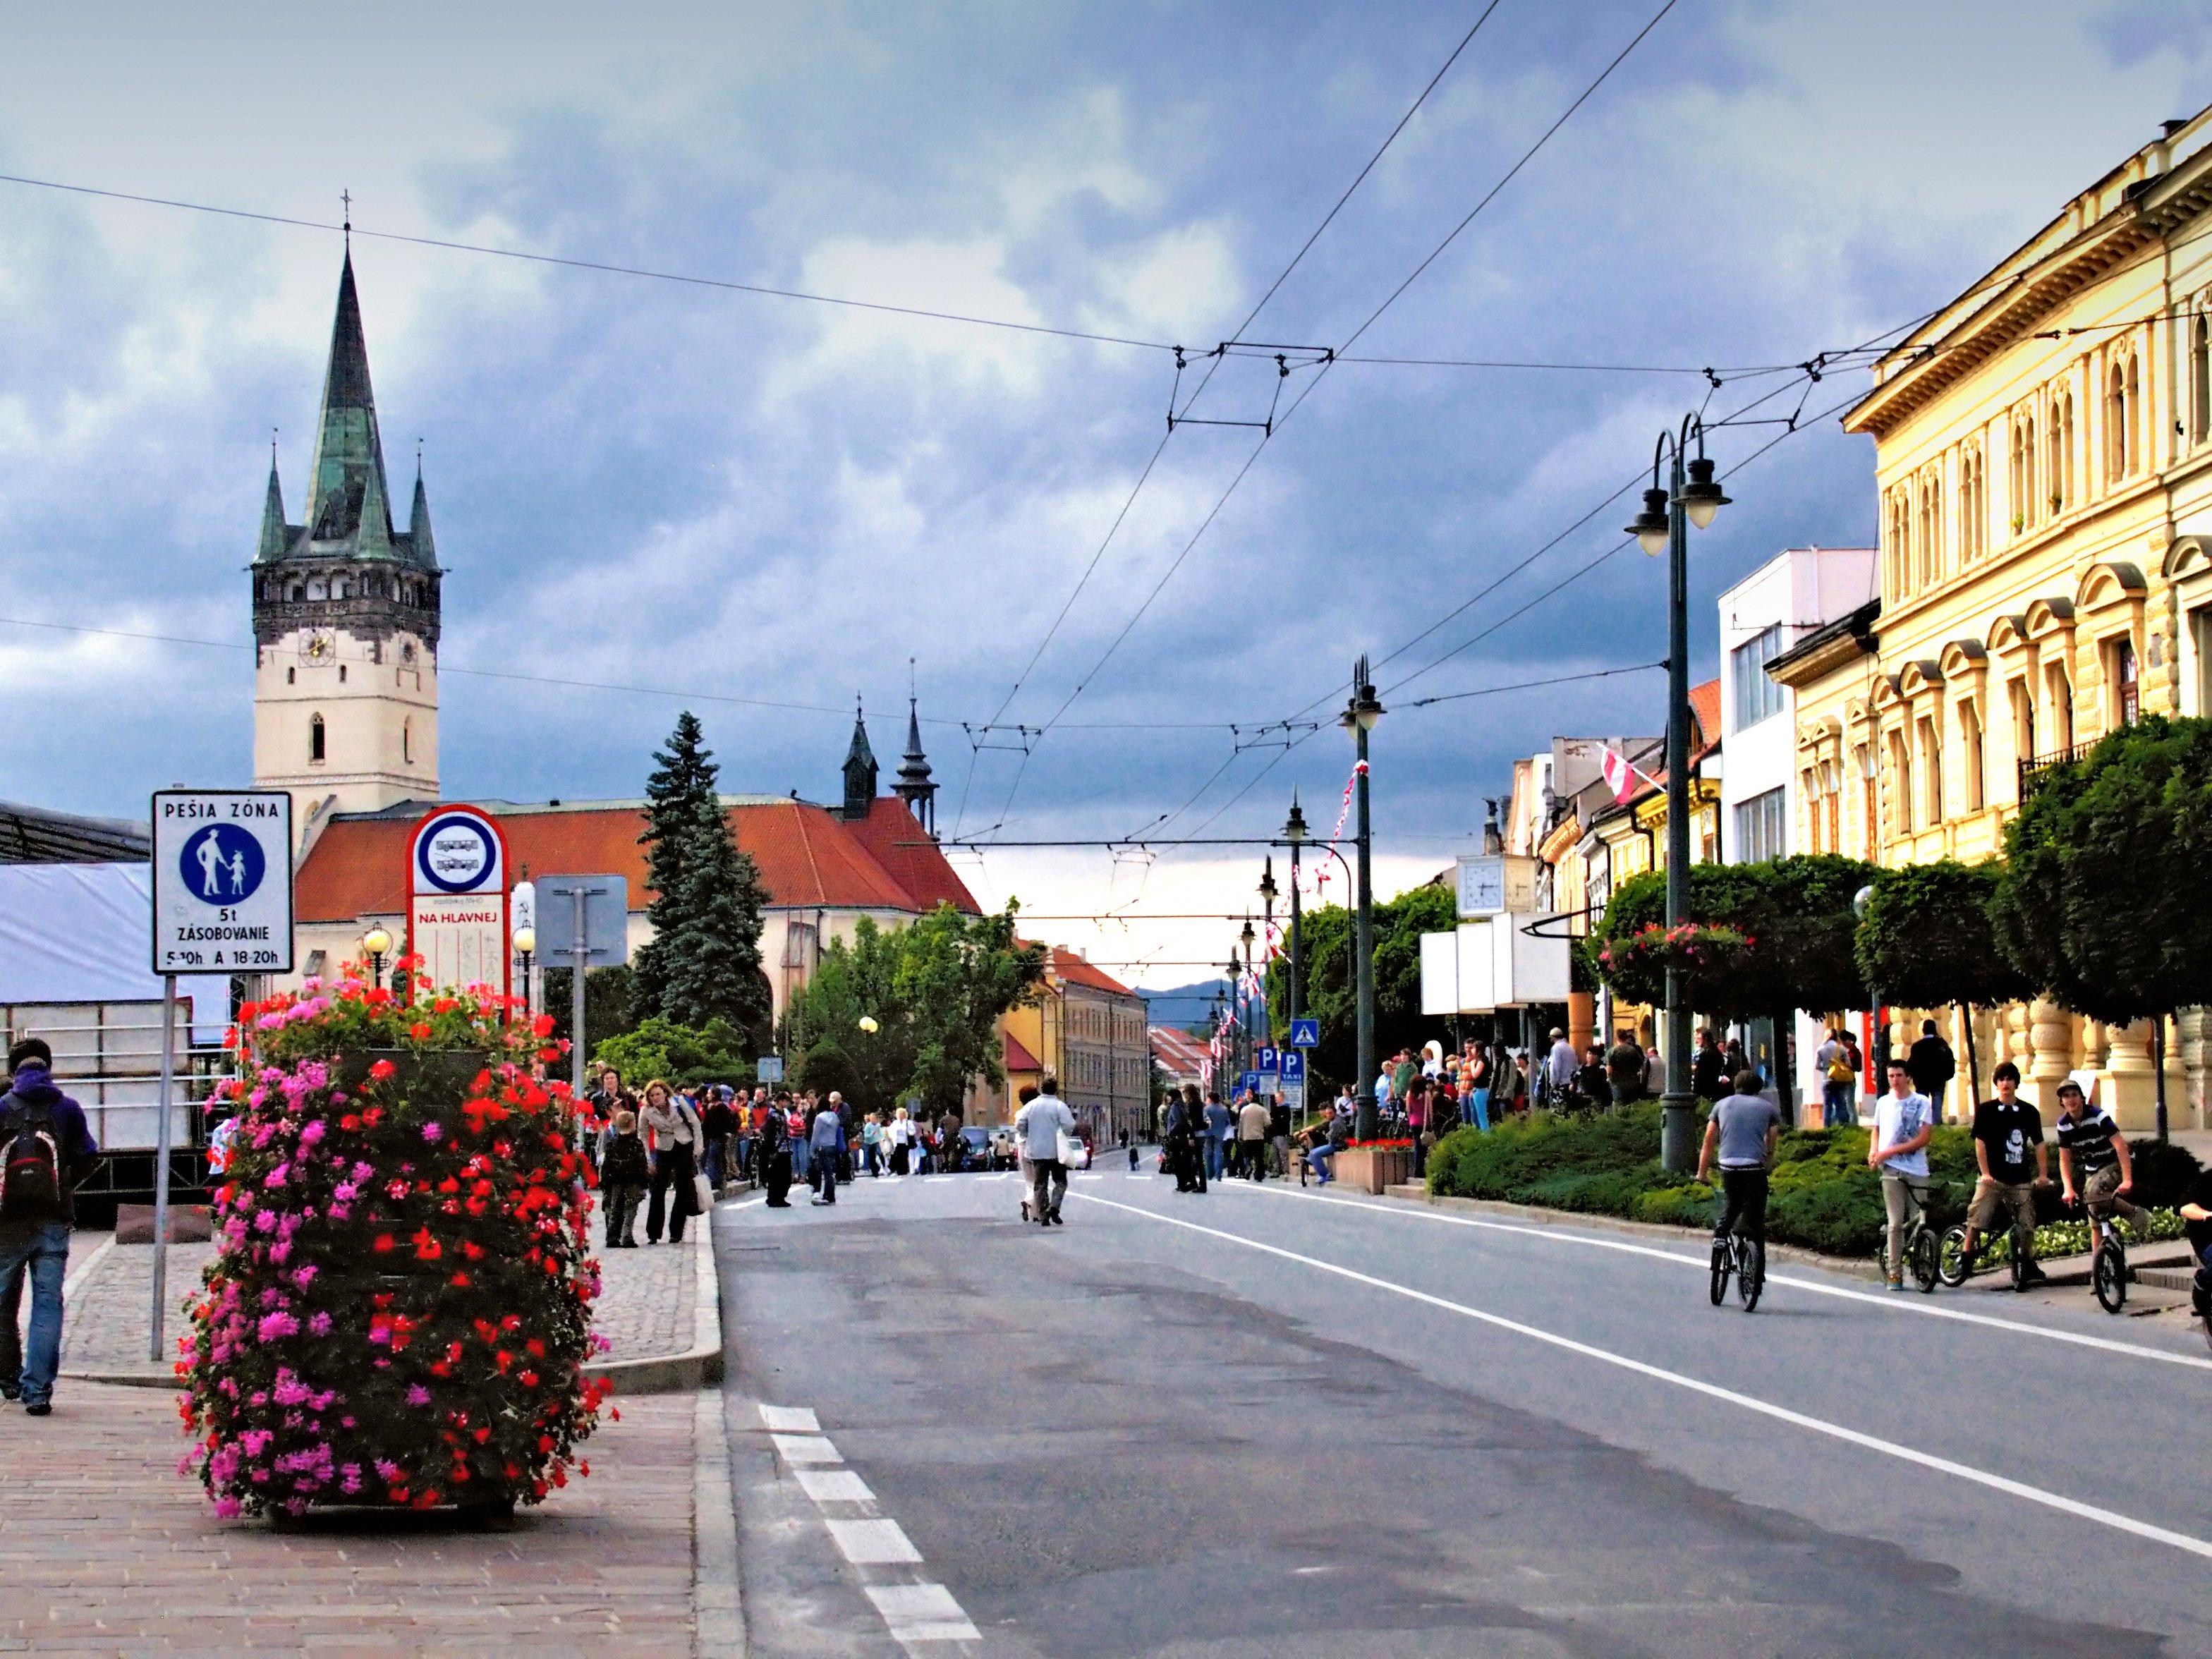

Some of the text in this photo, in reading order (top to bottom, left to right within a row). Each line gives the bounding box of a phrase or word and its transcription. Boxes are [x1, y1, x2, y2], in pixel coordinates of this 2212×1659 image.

[165, 799, 279, 818] PEŠIA ZÓNA
[419, 912, 497, 923] NA HLAVNEJ
[178, 923, 269, 940] ZÁSOBOVANIE
[214, 951, 224, 964] A
[1263, 1049, 1273, 1067] P
[1286, 1054, 1297, 1072] P
[1246, 1074, 1256, 1088] P
